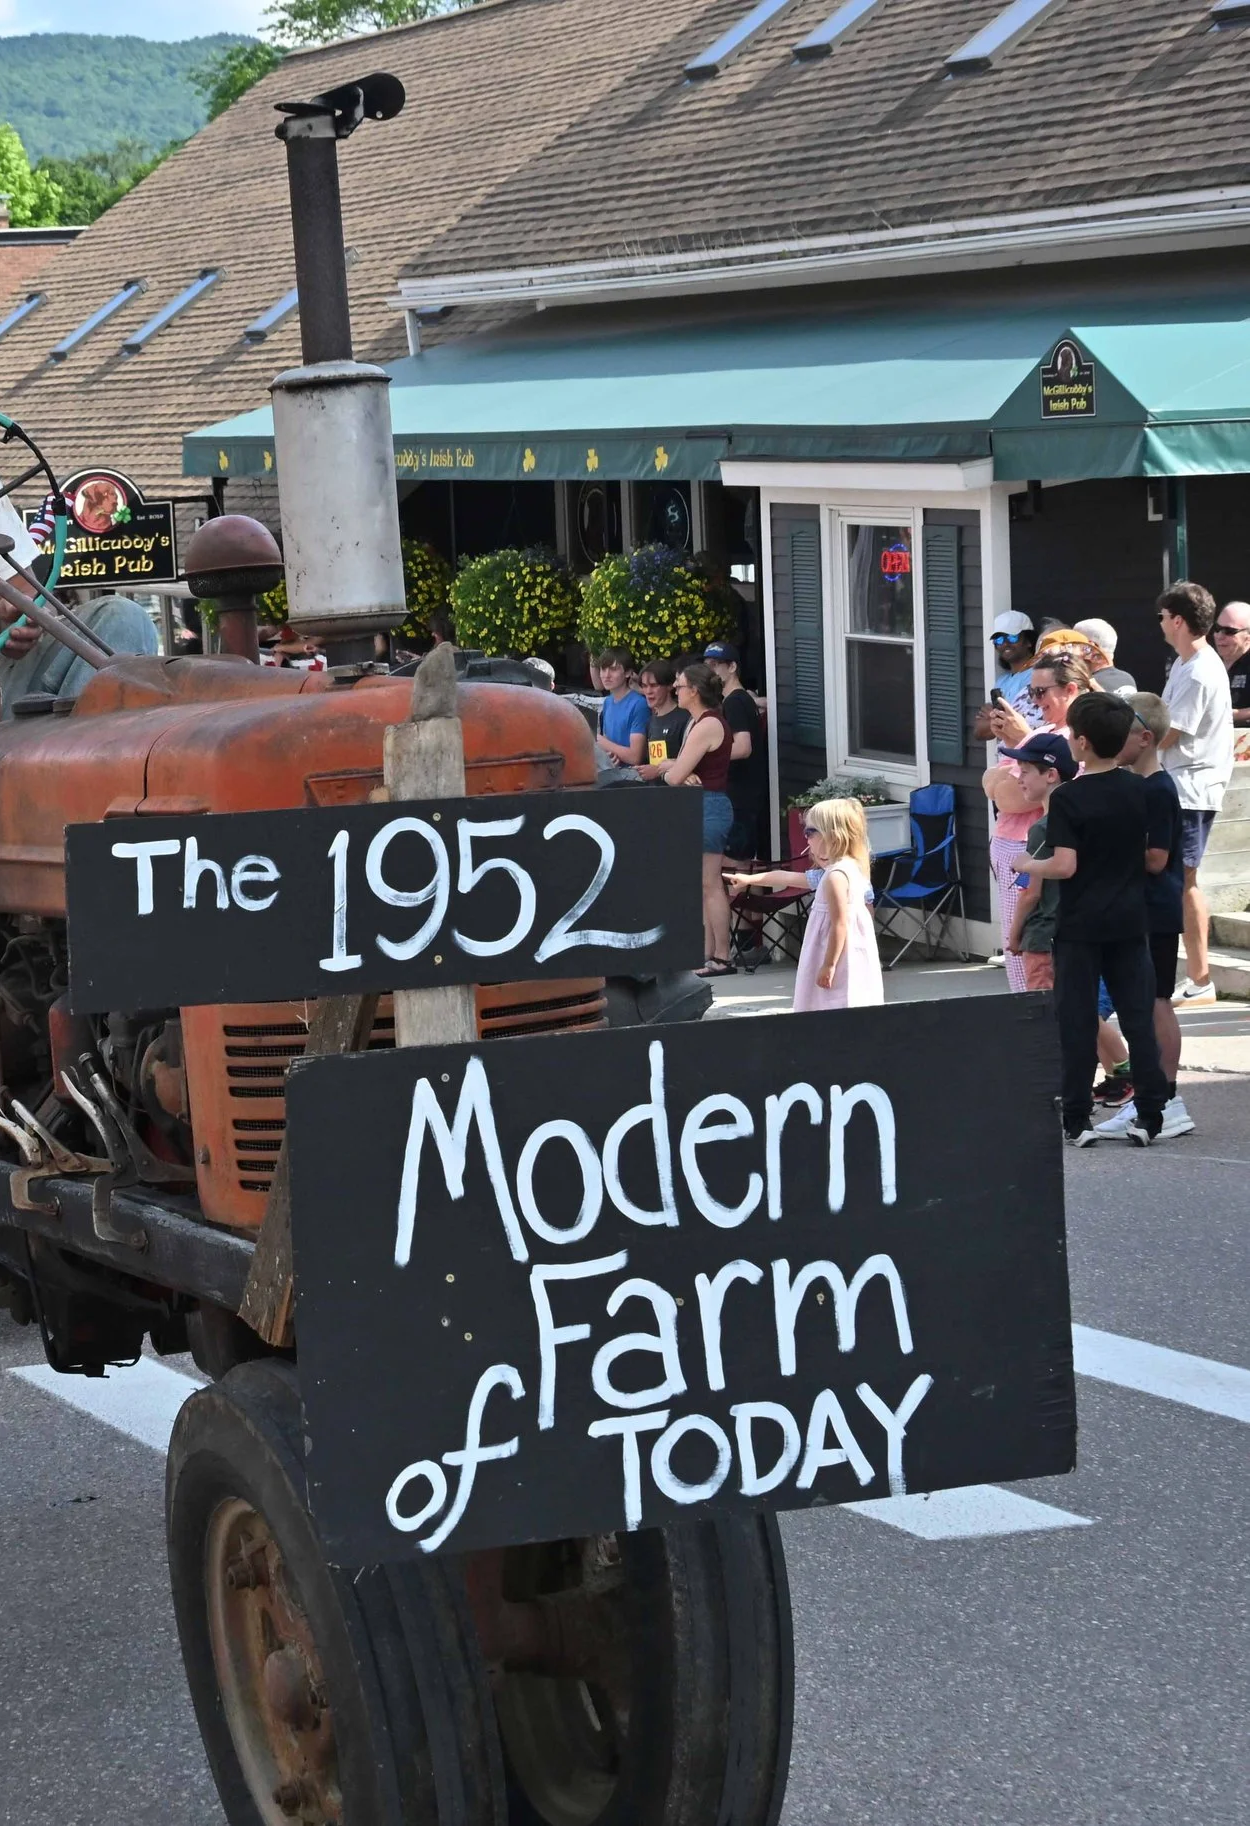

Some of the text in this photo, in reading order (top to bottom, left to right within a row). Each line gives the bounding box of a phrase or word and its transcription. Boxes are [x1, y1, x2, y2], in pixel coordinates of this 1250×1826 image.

[1050, 397, 1087, 411] Irish Pub
[430, 448, 454, 467] Irish
[456, 447, 475, 467] Pub
[60, 554, 154, 578] rish Pub
[650, 742, 663, 759] 26
[111, 813, 665, 971] The 1952
[393, 1040, 897, 1266] Modern
[529, 1249, 913, 1431] Farm
[385, 1364, 933, 1552] of TODAY
